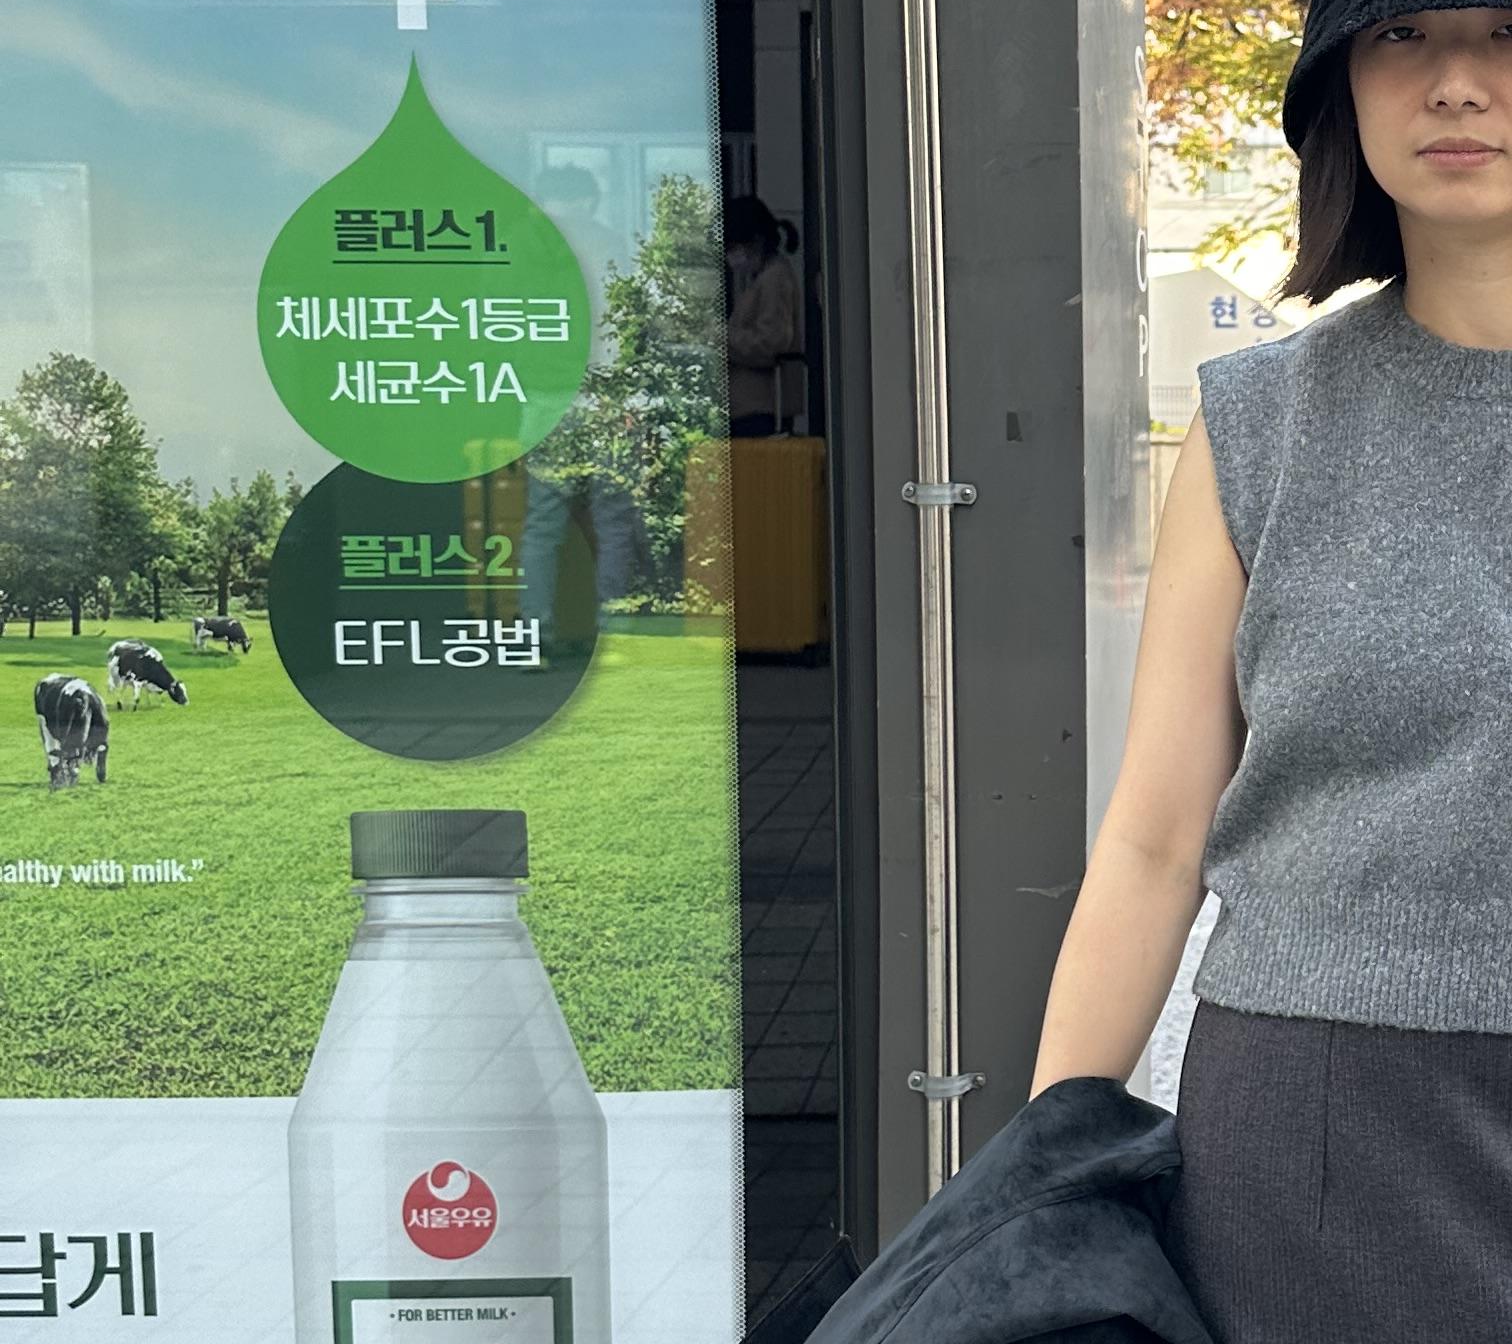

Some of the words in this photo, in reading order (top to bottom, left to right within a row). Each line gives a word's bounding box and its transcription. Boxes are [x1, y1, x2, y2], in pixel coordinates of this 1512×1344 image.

[276, 296, 571, 342] 체세포수1등급
[330, 359, 528, 406] 세균수1A
[334, 617, 541, 668] EFL공법
[70, 859, 125, 883] with
[407, 1206, 493, 1229] 서울우유
[398, 1308, 424, 1322] FOR
[426, 1308, 473, 1322] BETTER
[477, 1307, 509, 1321] MILK
